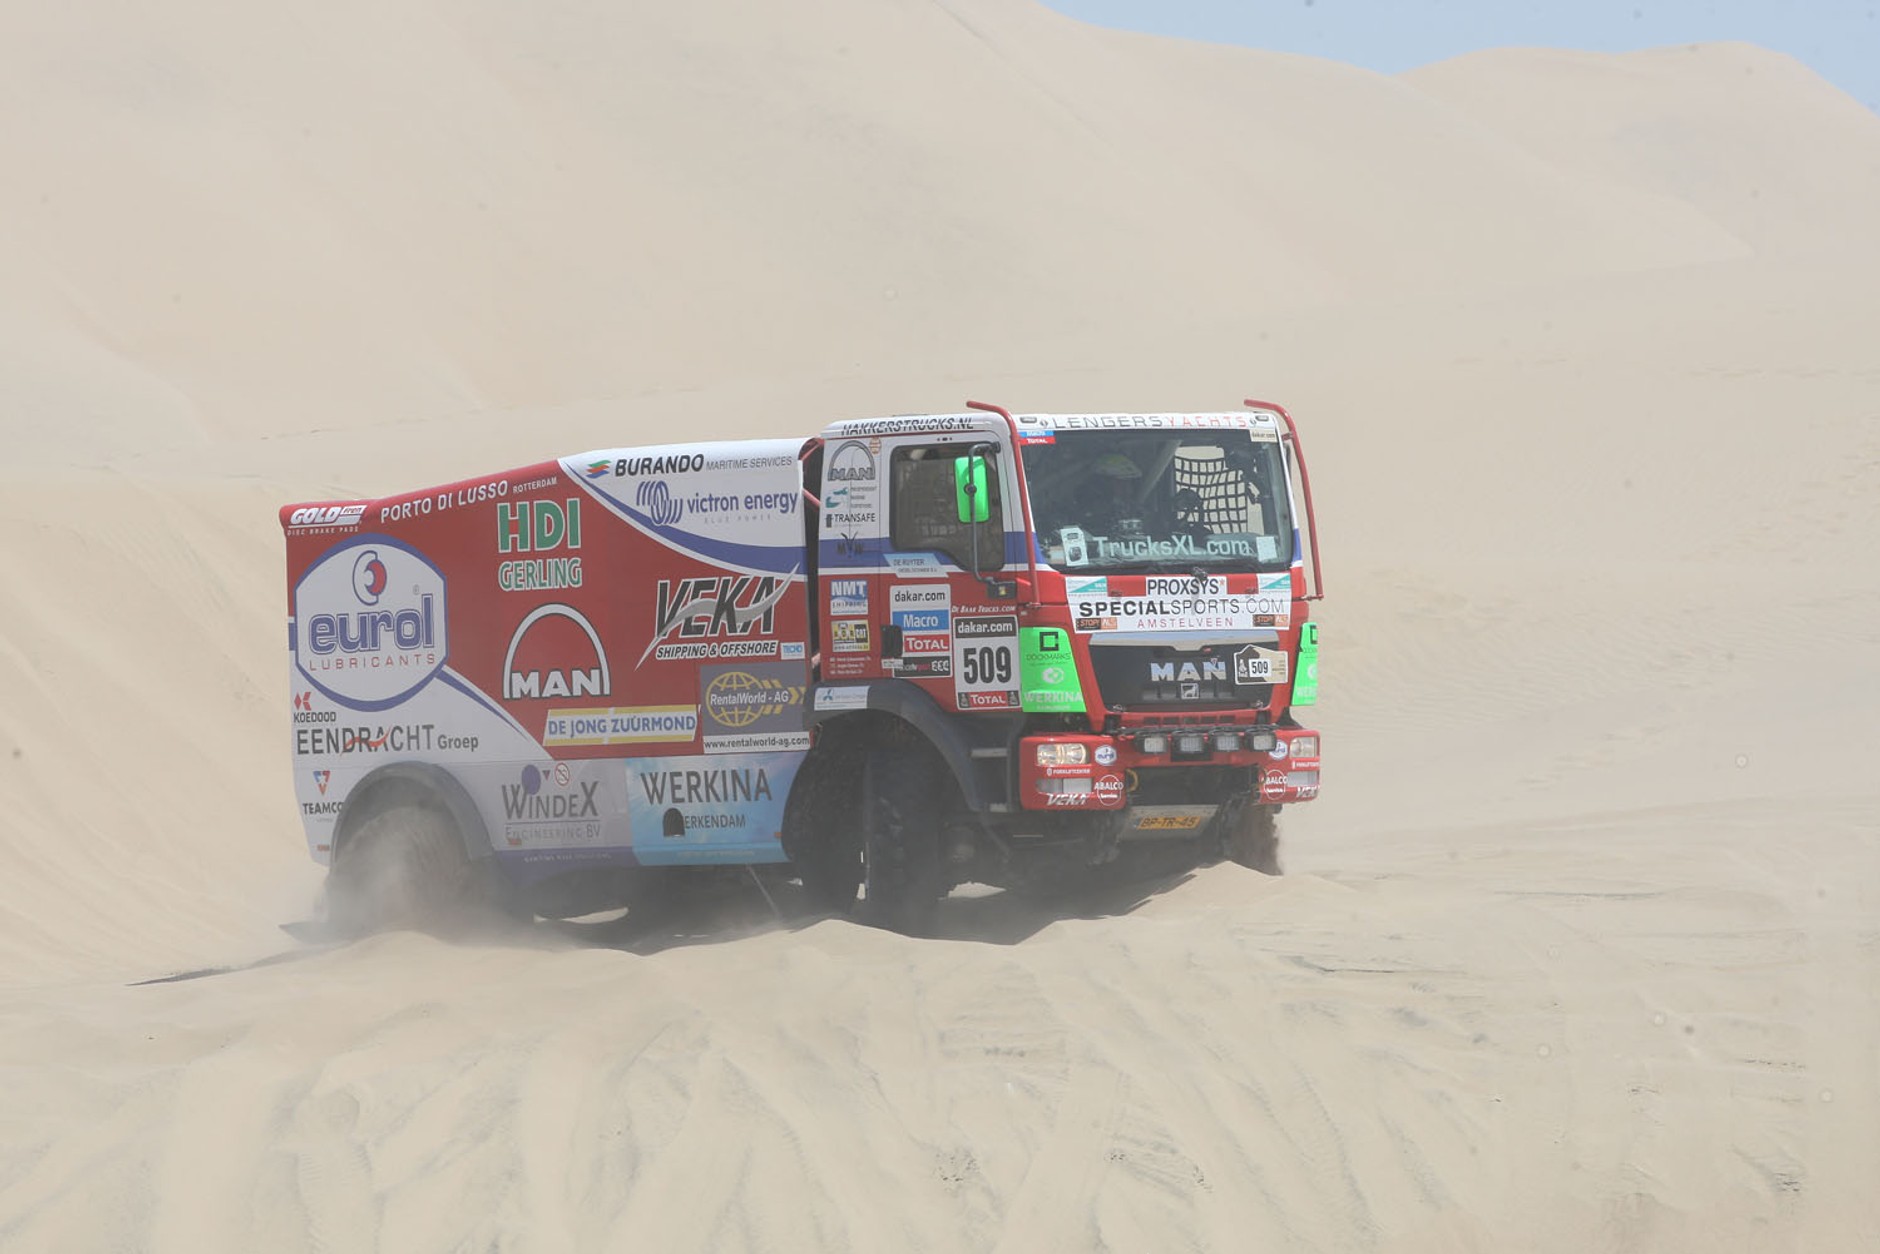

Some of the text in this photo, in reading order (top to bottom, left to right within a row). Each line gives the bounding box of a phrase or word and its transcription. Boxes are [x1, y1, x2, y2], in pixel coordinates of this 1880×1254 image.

[615, 453, 793, 477] BURANDO MARITIME SERVICES
[830, 467, 874, 481] MAN
[380, 477, 557, 523] PORTO DI LUSSO ROTTERDAM
[687, 492, 798, 514] victron energy
[290, 506, 341, 526] GOLD
[834, 513, 876, 523] TRANSAFE
[497, 498, 581, 553] HDI
[1093, 535, 1250, 556] TrucksXL.com
[498, 557, 582, 592] GERLING
[831, 580, 867, 596] NMT
[1147, 579, 1219, 595] PROXSYS
[895, 591, 945, 602] dakar.com
[655, 575, 776, 640] VEKA
[1079, 599, 1285, 616] SPECIALSPORTS.COM
[309, 593, 434, 655] eurol
[903, 614, 938, 628] Macro
[958, 622, 1013, 634] dakar.com
[1137, 618, 1234, 629] AMSTELVEEN
[656, 641, 778, 660] SHIPPING & OFFSHORE
[906, 637, 949, 651] TOTAL
[309, 653, 435, 671] LUBRICANTS
[963, 646, 1012, 684] 509
[1251, 661, 1269, 674] 509
[1150, 662, 1227, 682] MAN
[510, 668, 602, 698] MAN
[710, 692, 766, 705] RentalWorld
[774, 691, 789, 702] AG
[970, 693, 1006, 704] TOTAL
[1025, 692, 1082, 702] WERKINA
[293, 712, 336, 723] KOEDOOD
[548, 719, 566, 735] DE
[570, 719, 607, 738] JONG
[297, 725, 479, 756] EENDRACHT Groep
[705, 737, 810, 748] www.rentalworld-ag.com
[640, 768, 772, 805] WERKINA
[684, 814, 746, 829] ERKENDAM
